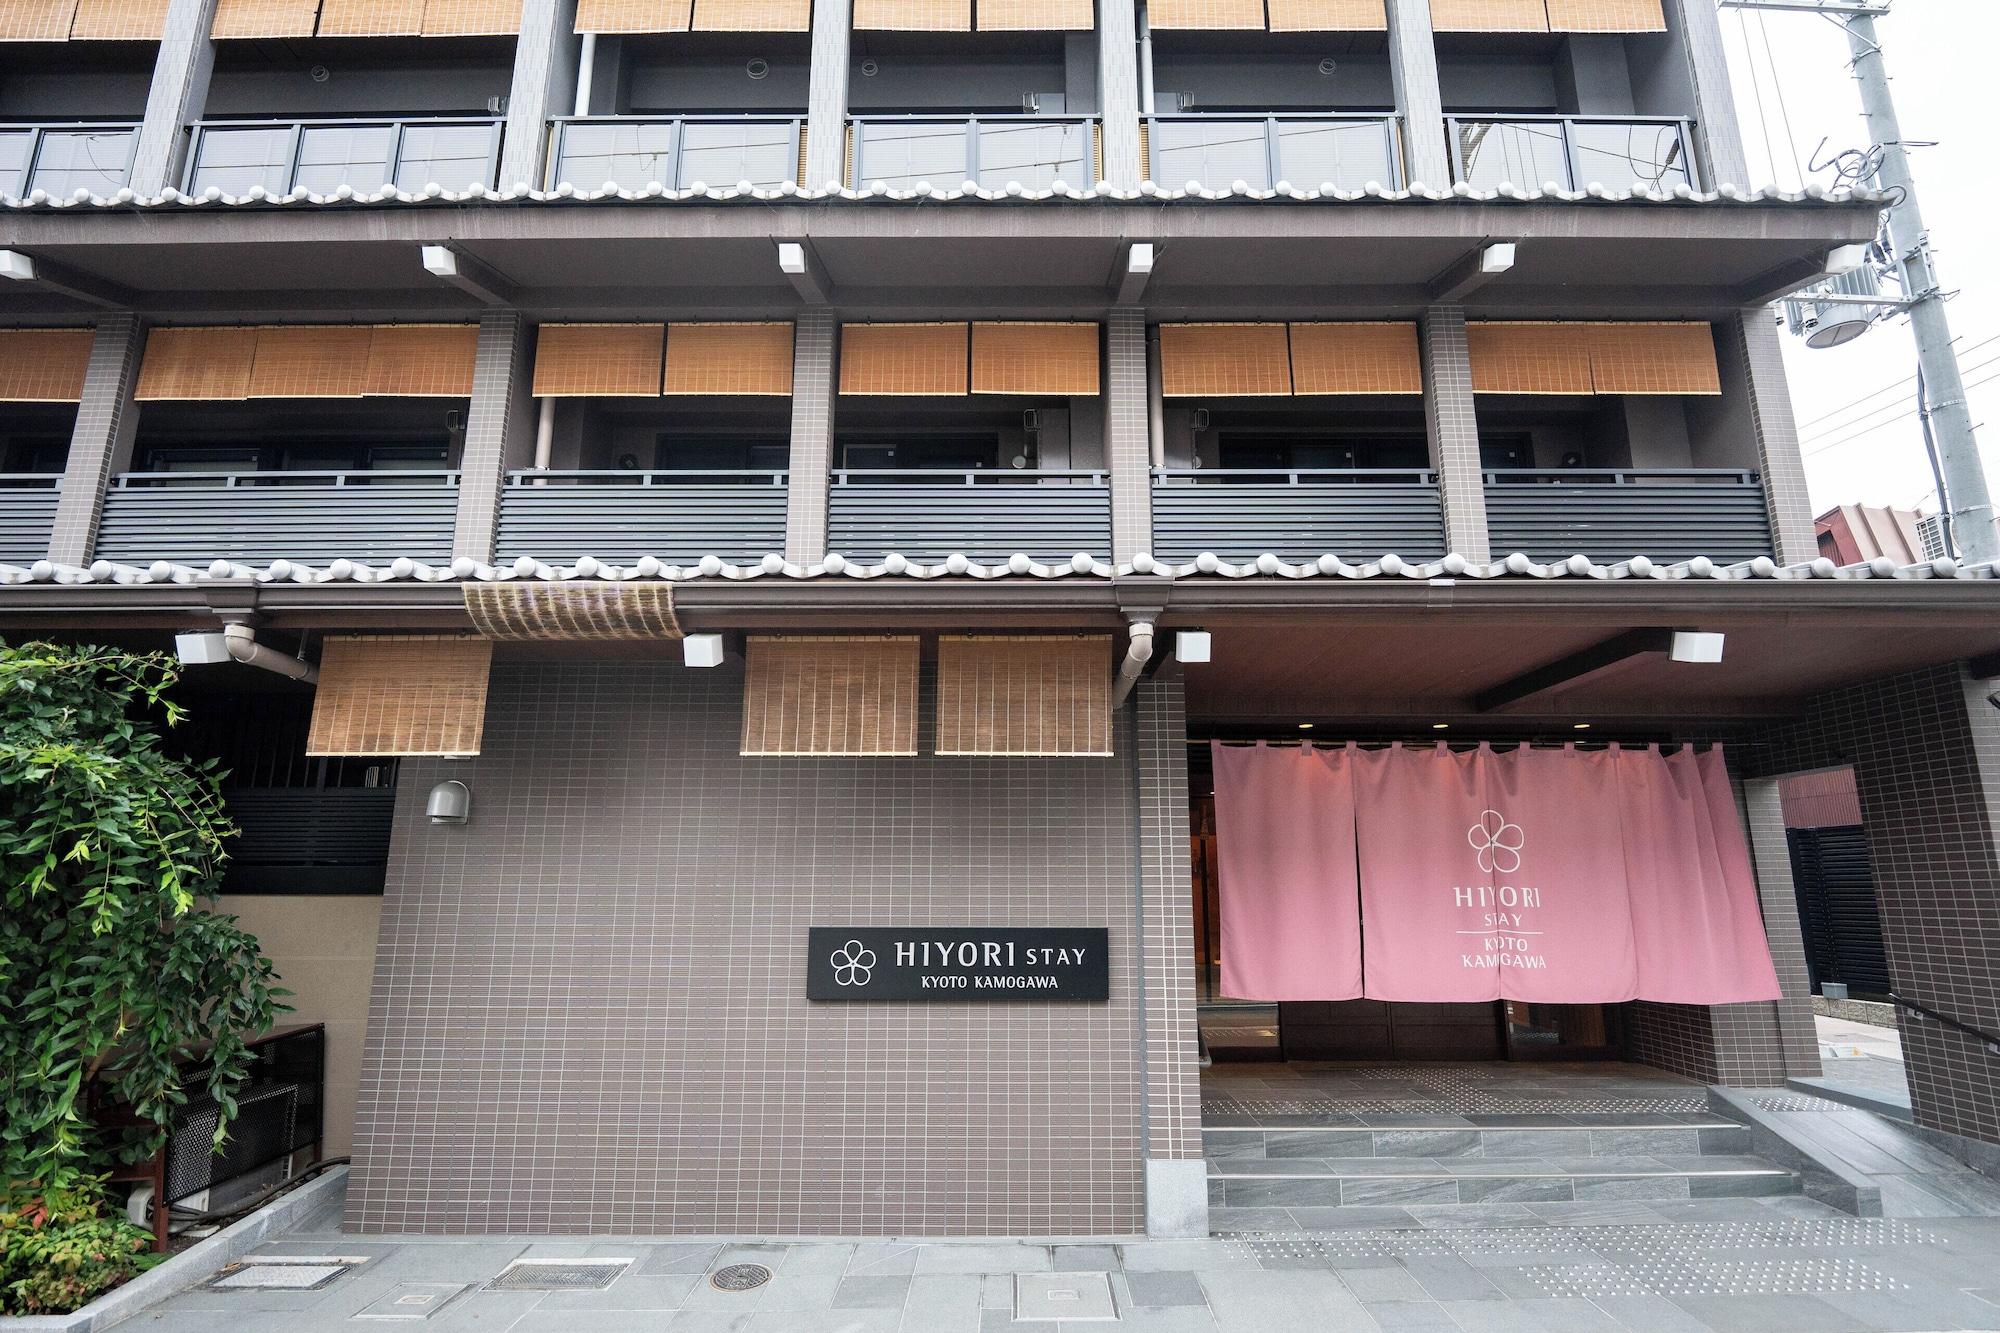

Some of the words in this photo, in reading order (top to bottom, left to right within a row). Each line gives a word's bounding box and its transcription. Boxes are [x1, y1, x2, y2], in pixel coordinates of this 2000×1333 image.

[894, 941, 1015, 967] HIYORI
[1026, 948, 1086, 965] STAY
[1462, 953, 1547, 969] KAMGAWA
[921, 975, 967, 989] KYOTO
[974, 975, 1058, 989] KAMOGAWA
